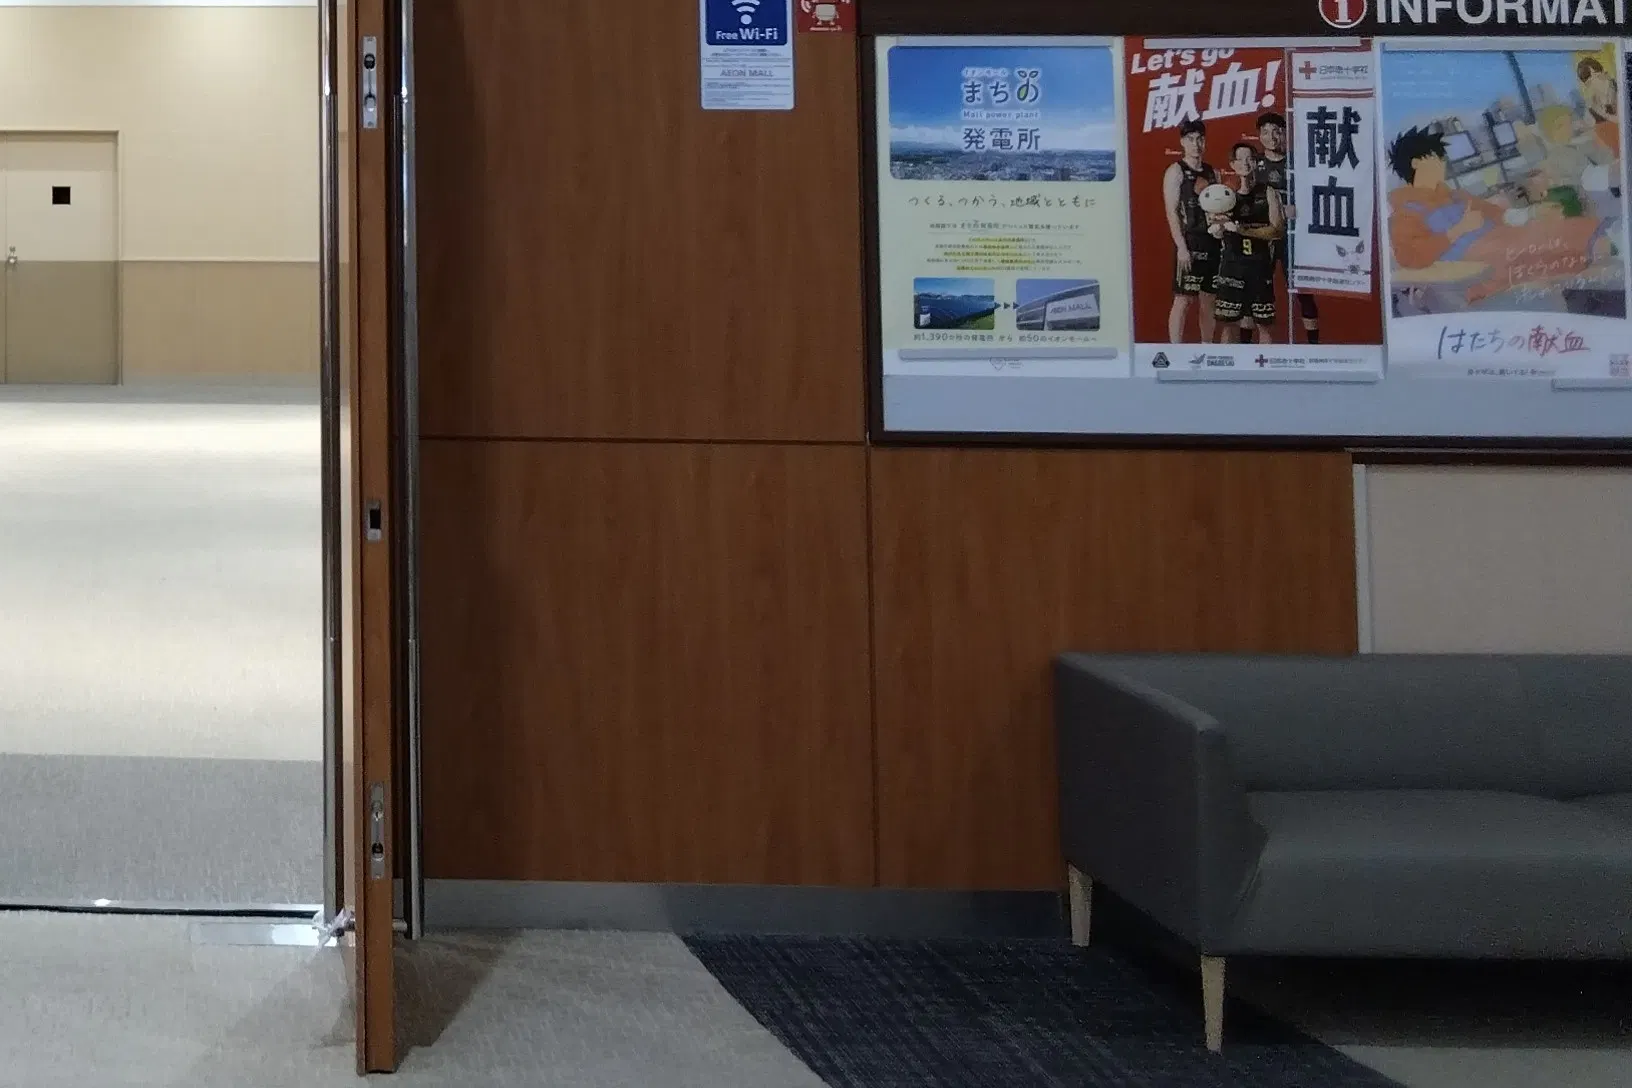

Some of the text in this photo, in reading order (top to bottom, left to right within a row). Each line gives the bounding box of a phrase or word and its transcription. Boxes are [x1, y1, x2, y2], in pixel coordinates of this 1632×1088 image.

[716, 28, 778, 40] Free Wi-Fi
[963, 127, 1041, 151] 発電所
[1306, 106, 1362, 238] 献血
[1437, 324, 1591, 359] はたちの献血
